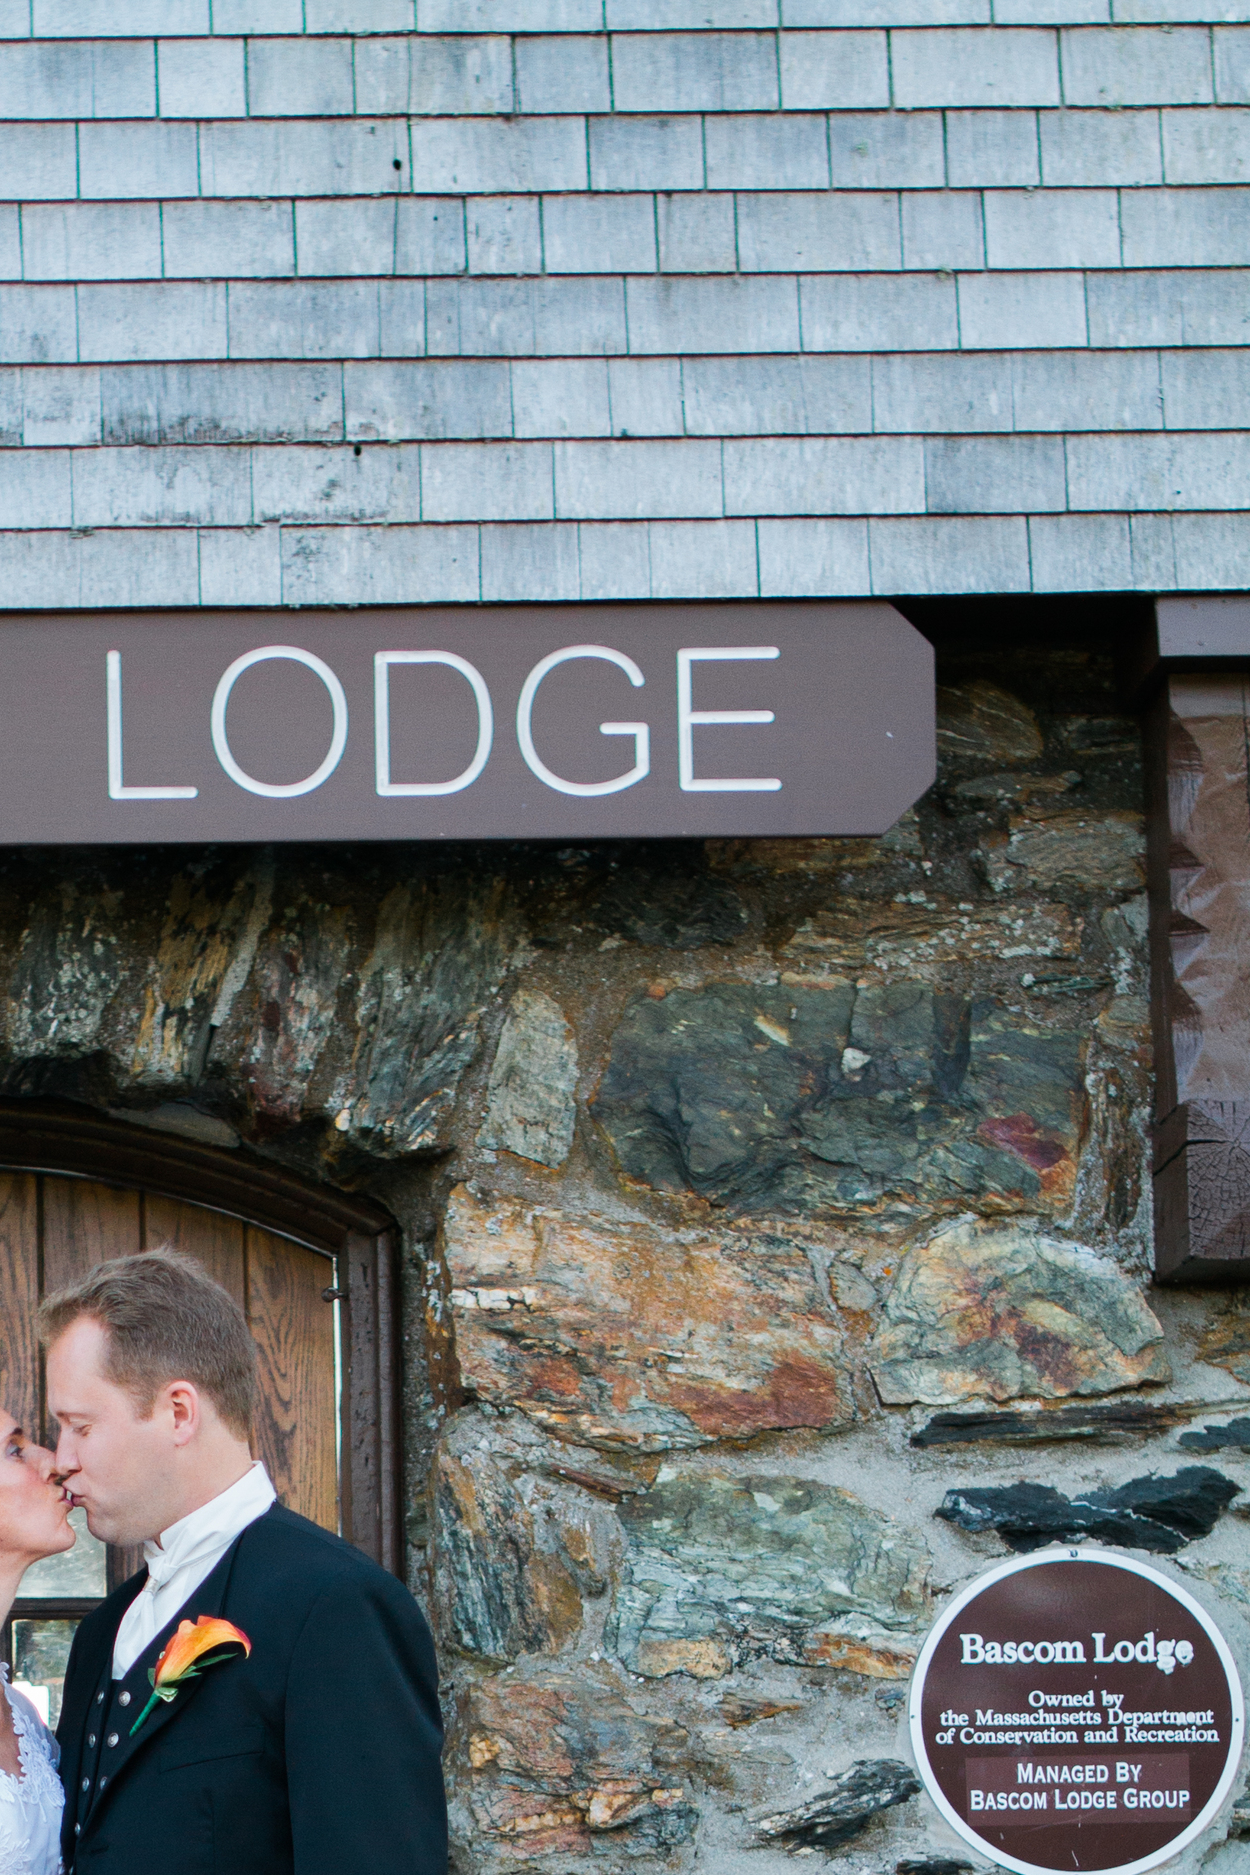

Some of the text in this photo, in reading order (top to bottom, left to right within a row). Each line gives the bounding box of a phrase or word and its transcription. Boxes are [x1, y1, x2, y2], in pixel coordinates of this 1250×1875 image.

[106, 644, 783, 800] LODGE
[959, 1632, 1194, 1674] Bascom Lodge
[1028, 1690, 1124, 1711] Owned by
[940, 1709, 1214, 1728] the Massachusetts Department
[935, 1726, 1220, 1744] of Conservation and Recreation
[1017, 1763, 1108, 1784] MANAGED
[970, 1788, 1190, 1810] BASCOM LODGE GROUP
